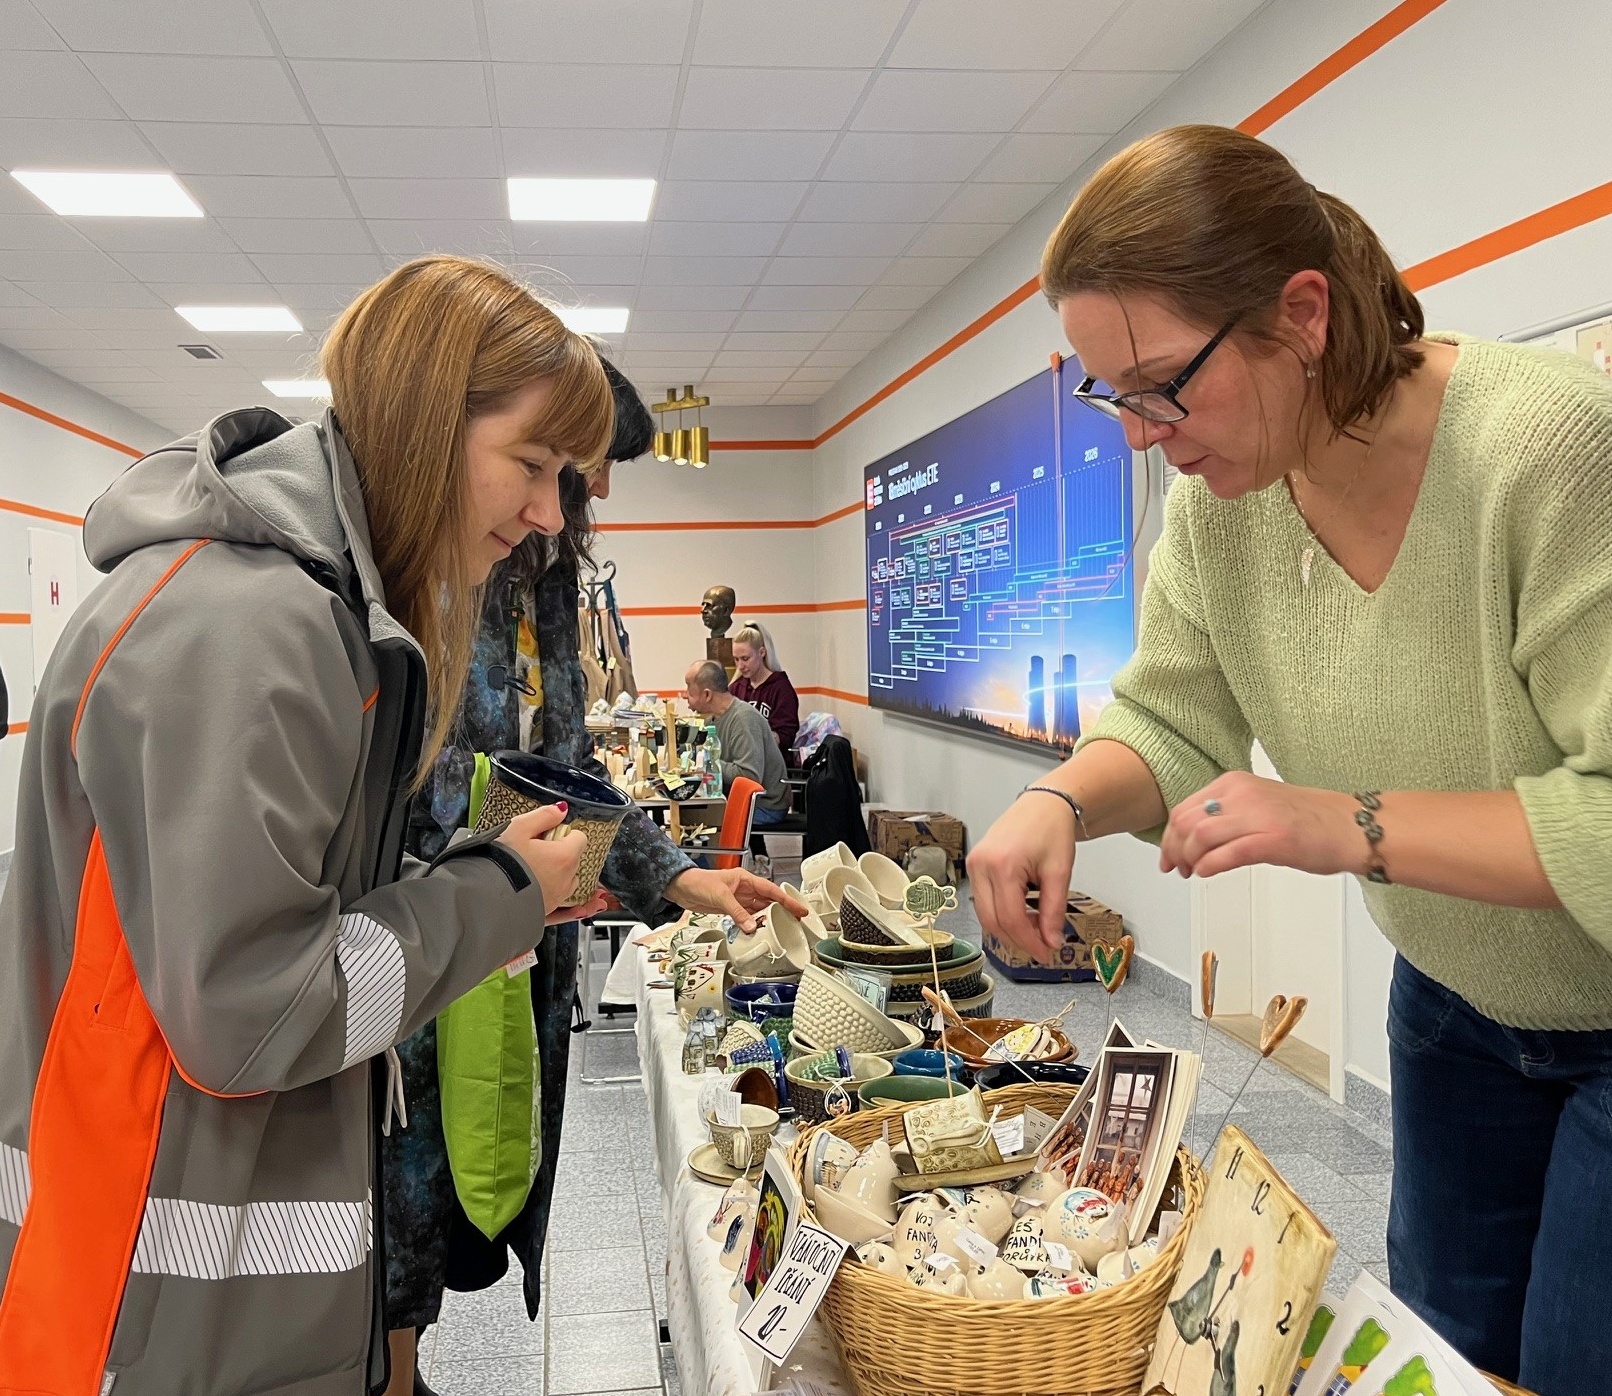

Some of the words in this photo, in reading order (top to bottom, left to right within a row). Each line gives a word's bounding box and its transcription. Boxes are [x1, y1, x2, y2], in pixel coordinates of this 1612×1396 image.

[50, 581, 60, 606] H
[1250, 1179, 1271, 1216] 12
[789, 1231, 841, 1276] VÁNOČNÍ
[774, 1267, 816, 1305] PŘÁNÍ
[1275, 1300, 1293, 1336] 2
